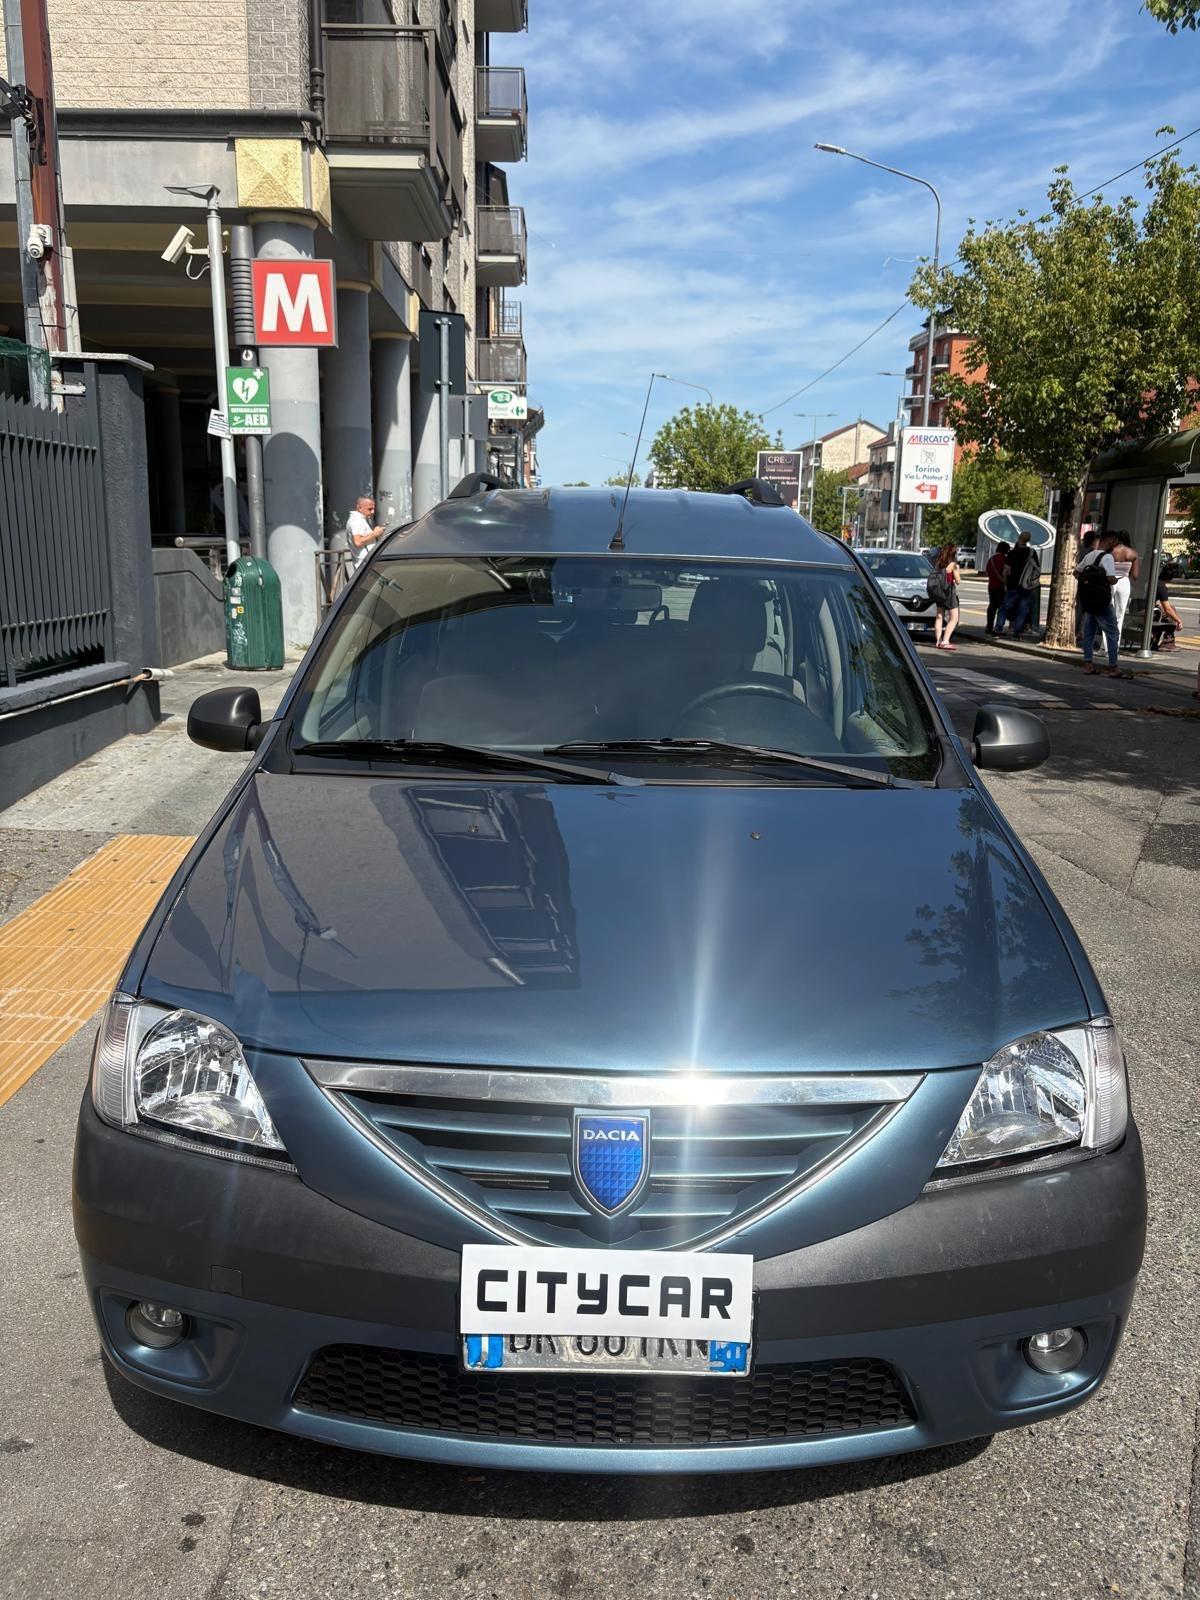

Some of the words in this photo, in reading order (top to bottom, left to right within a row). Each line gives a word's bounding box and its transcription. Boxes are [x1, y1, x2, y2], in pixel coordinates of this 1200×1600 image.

[262, 273, 328, 333] M
[245, 414, 268, 426] AED
[914, 465, 940, 473] Torino
[583, 1129, 640, 1141] DACIA
[477, 1269, 732, 1319] CITYCAR
